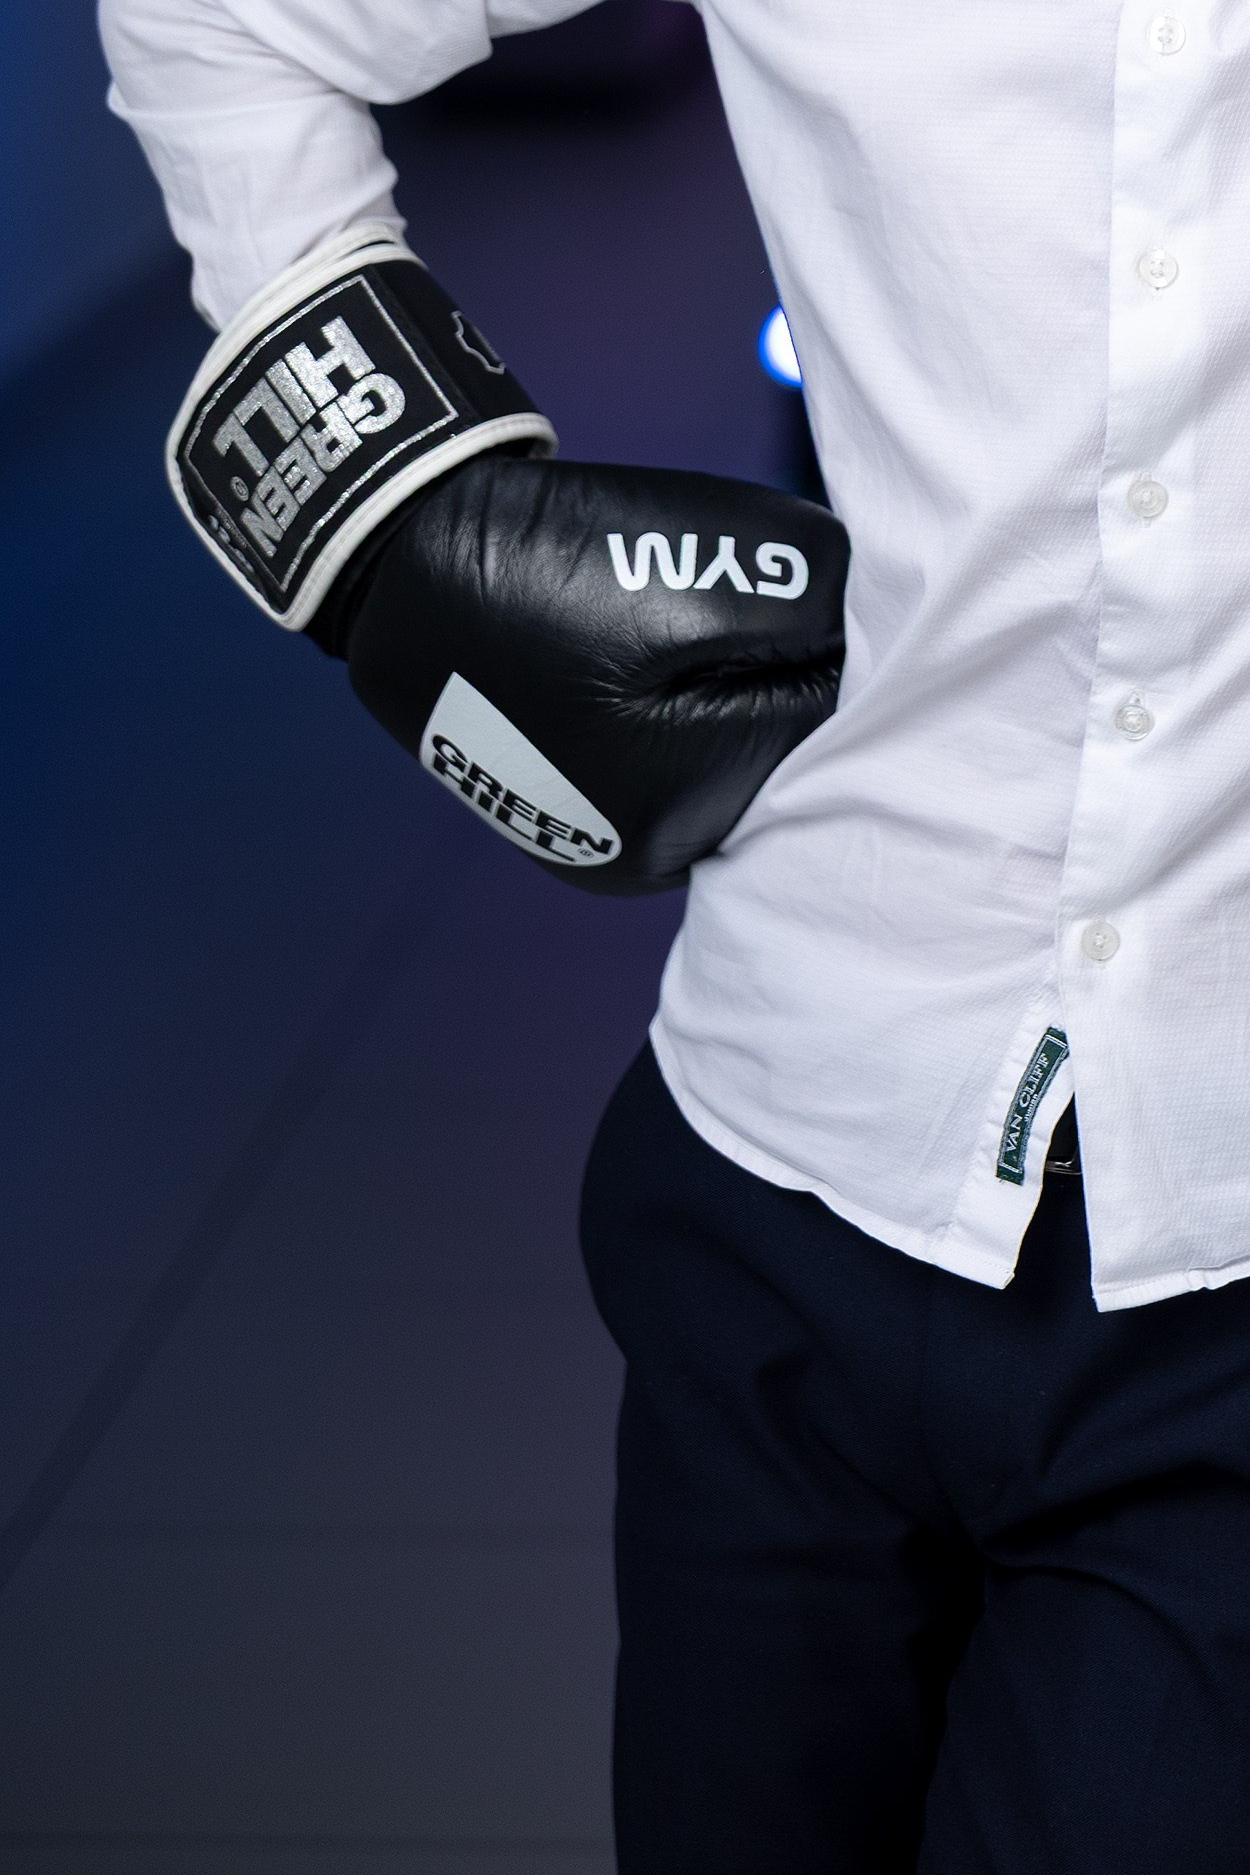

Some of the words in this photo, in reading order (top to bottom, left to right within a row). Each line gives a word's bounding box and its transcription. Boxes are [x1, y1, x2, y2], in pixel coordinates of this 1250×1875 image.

[212, 315, 376, 477] HILL
[241, 372, 406, 558] GREEN
[606, 531, 809, 600] GYM
[432, 734, 613, 855] GREEN
[433, 753, 576, 862] HILL
[1005, 1113, 1022, 1152] VAN
[1020, 1051, 1049, 1108] CLIFF
